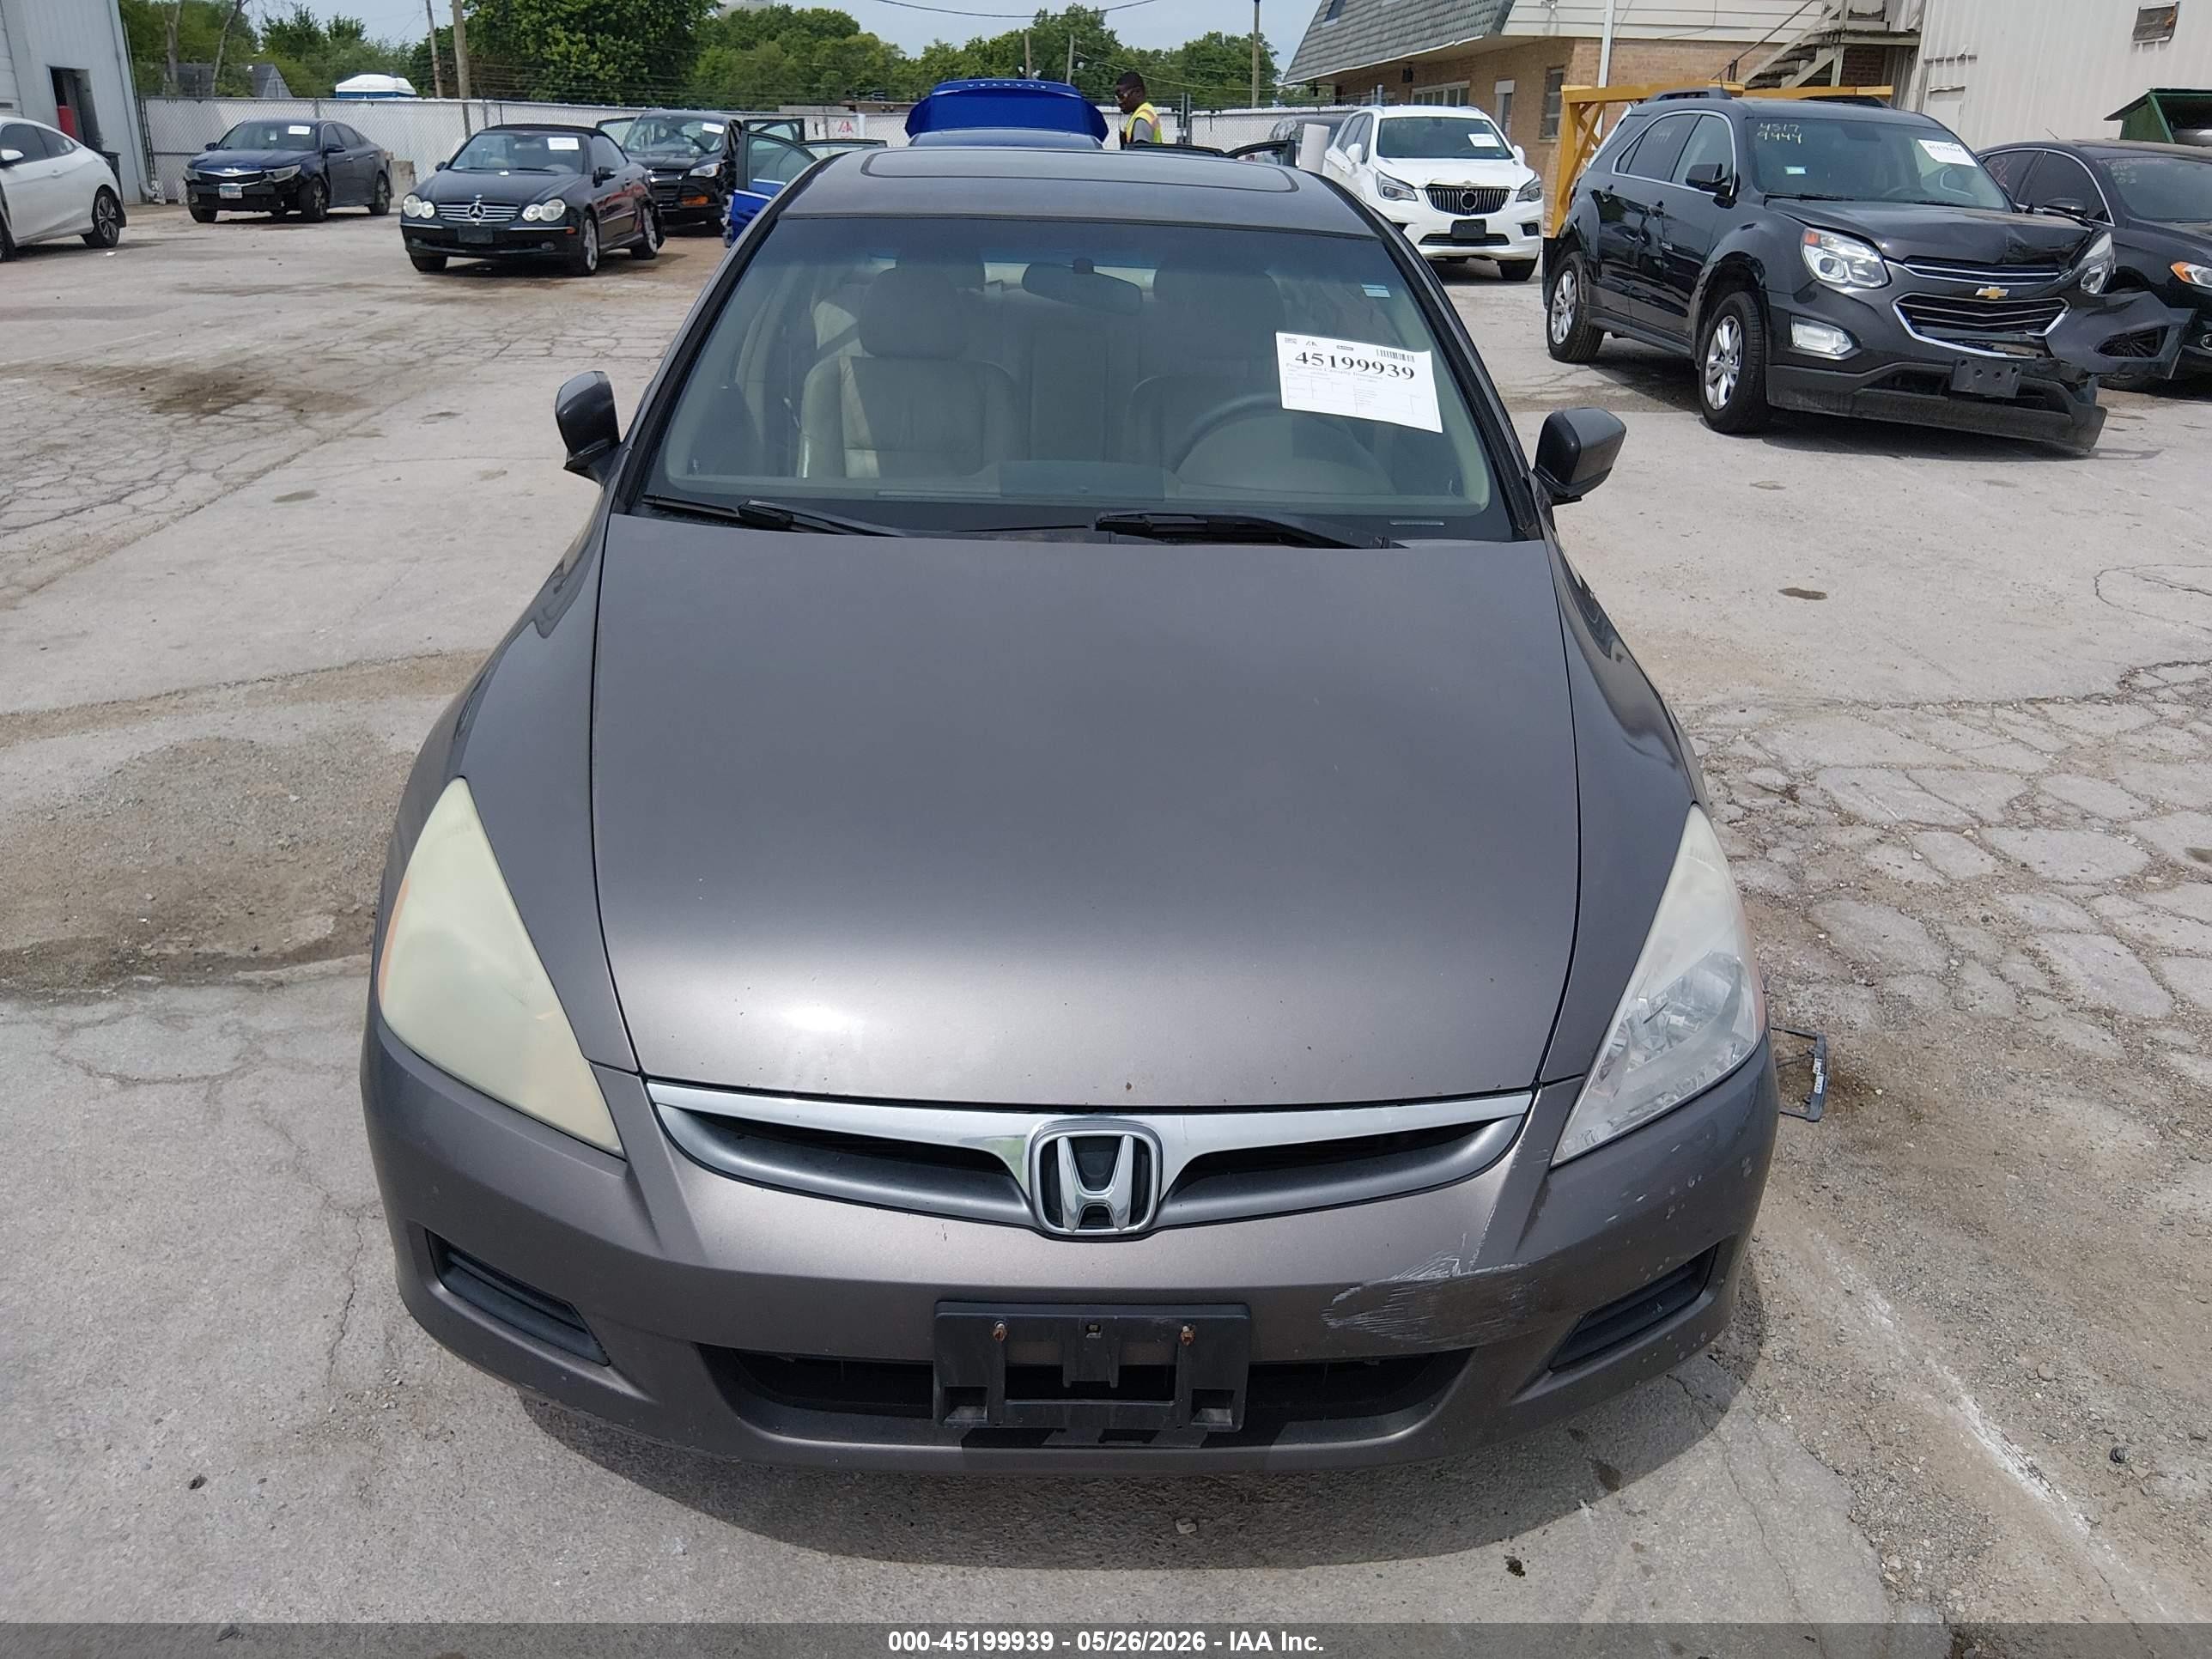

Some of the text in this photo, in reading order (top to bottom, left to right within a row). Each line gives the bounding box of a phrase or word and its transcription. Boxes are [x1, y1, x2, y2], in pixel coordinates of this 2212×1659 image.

[1760, 123, 1800, 132] 4517
[1757, 131, 1802, 144] 9444
[1295, 351, 1415, 380] 45199939
